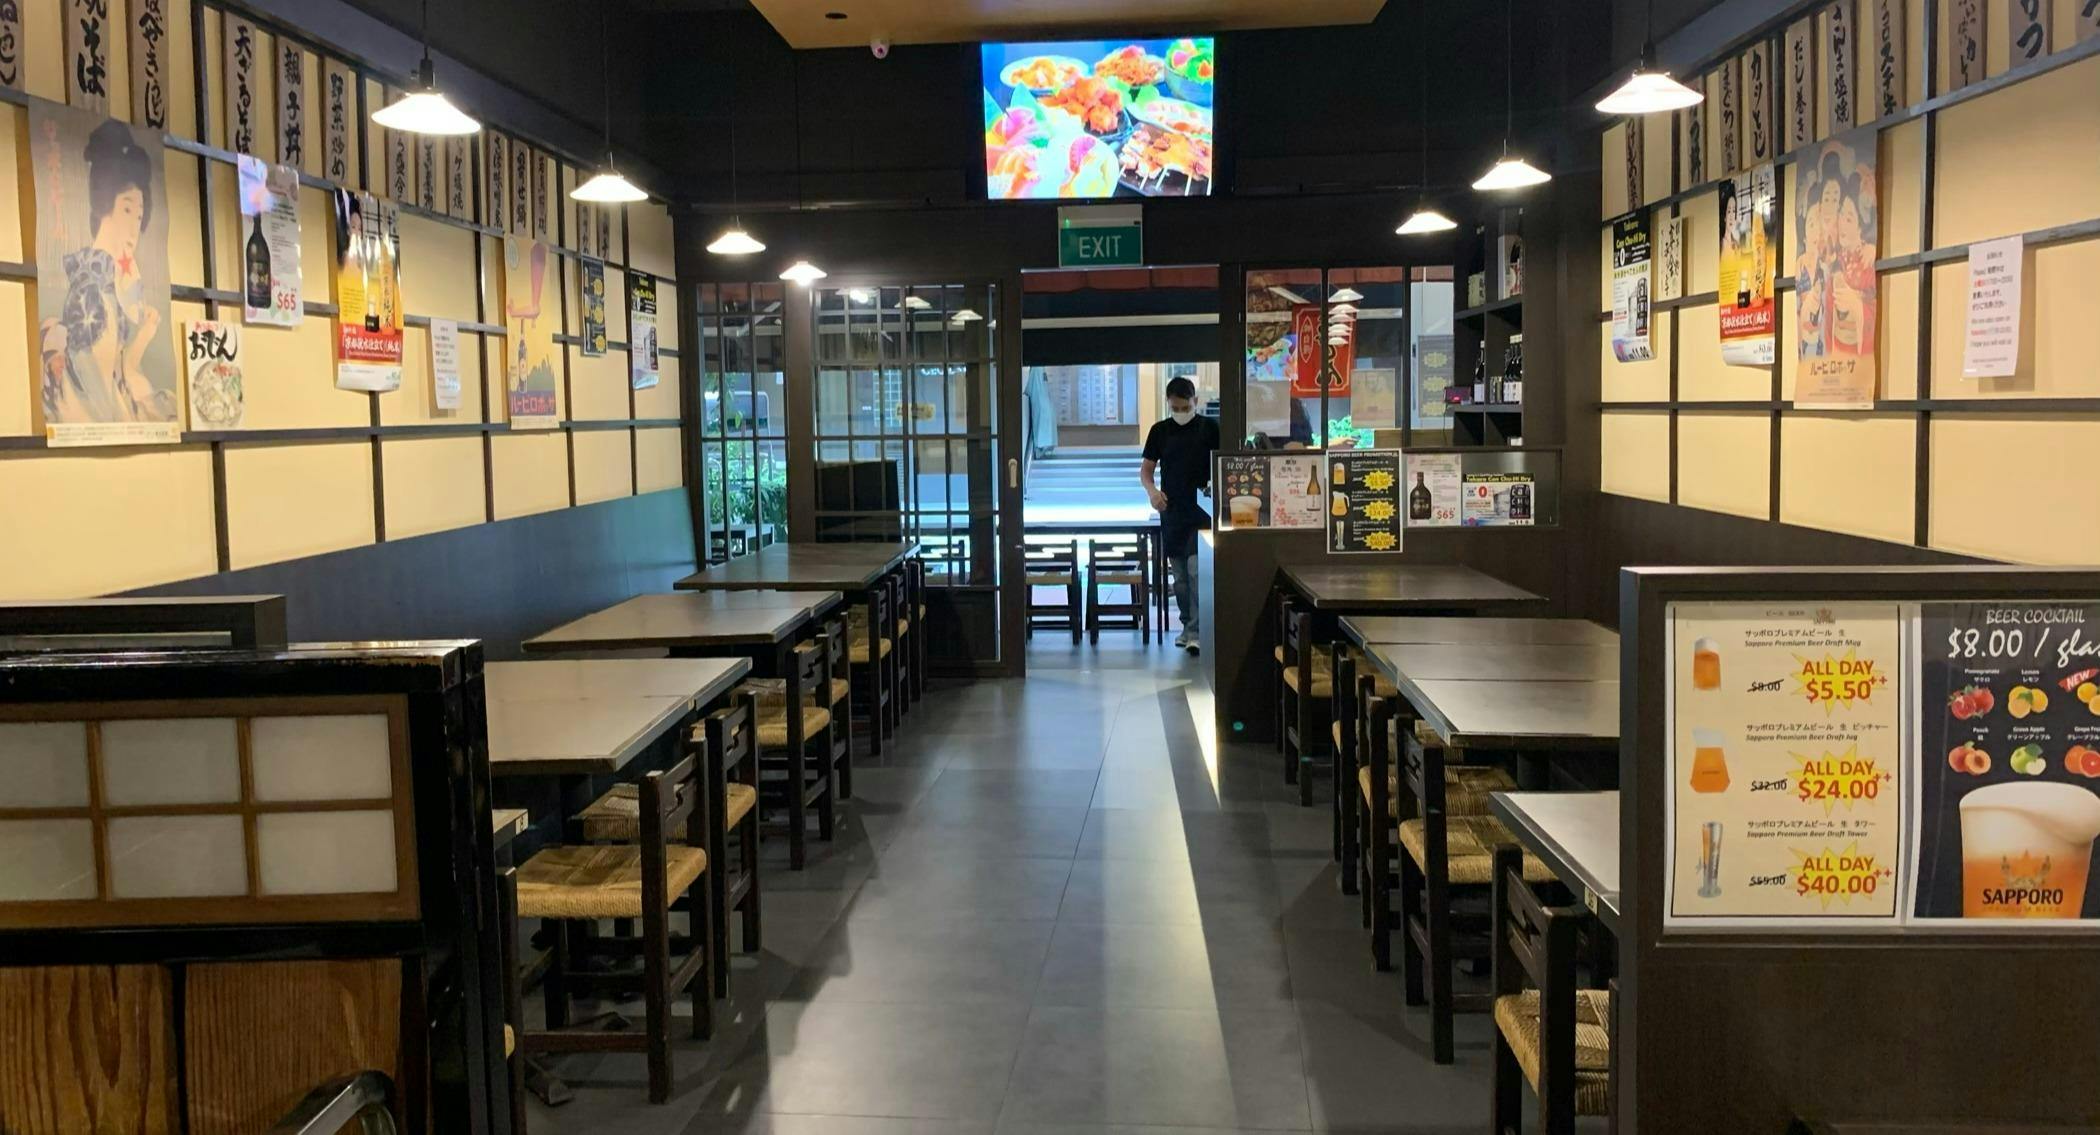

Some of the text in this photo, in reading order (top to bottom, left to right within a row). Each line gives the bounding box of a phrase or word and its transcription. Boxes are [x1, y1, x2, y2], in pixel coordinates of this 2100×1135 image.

[284, 46, 301, 165] 親子丼
[1079, 235, 1122, 259] EXIT
[277, 295, 297, 311] $65
[188, 328, 238, 362] おでん
[1437, 510, 1455, 519] $65
[1986, 608, 2085, 624] BEER COCKTAIL
[1948, 627, 2023, 659] $8.00
[2034, 628, 2050, 658] /
[1803, 660, 1874, 677] ALL DAY
[2066, 669, 2091, 690] NEW
[1776, 733, 1808, 741] Premium
[1803, 760, 1875, 776] ALL DAY
[1803, 857, 1874, 873] ALL DAY
[1982, 887, 2064, 905] SAPPORO
